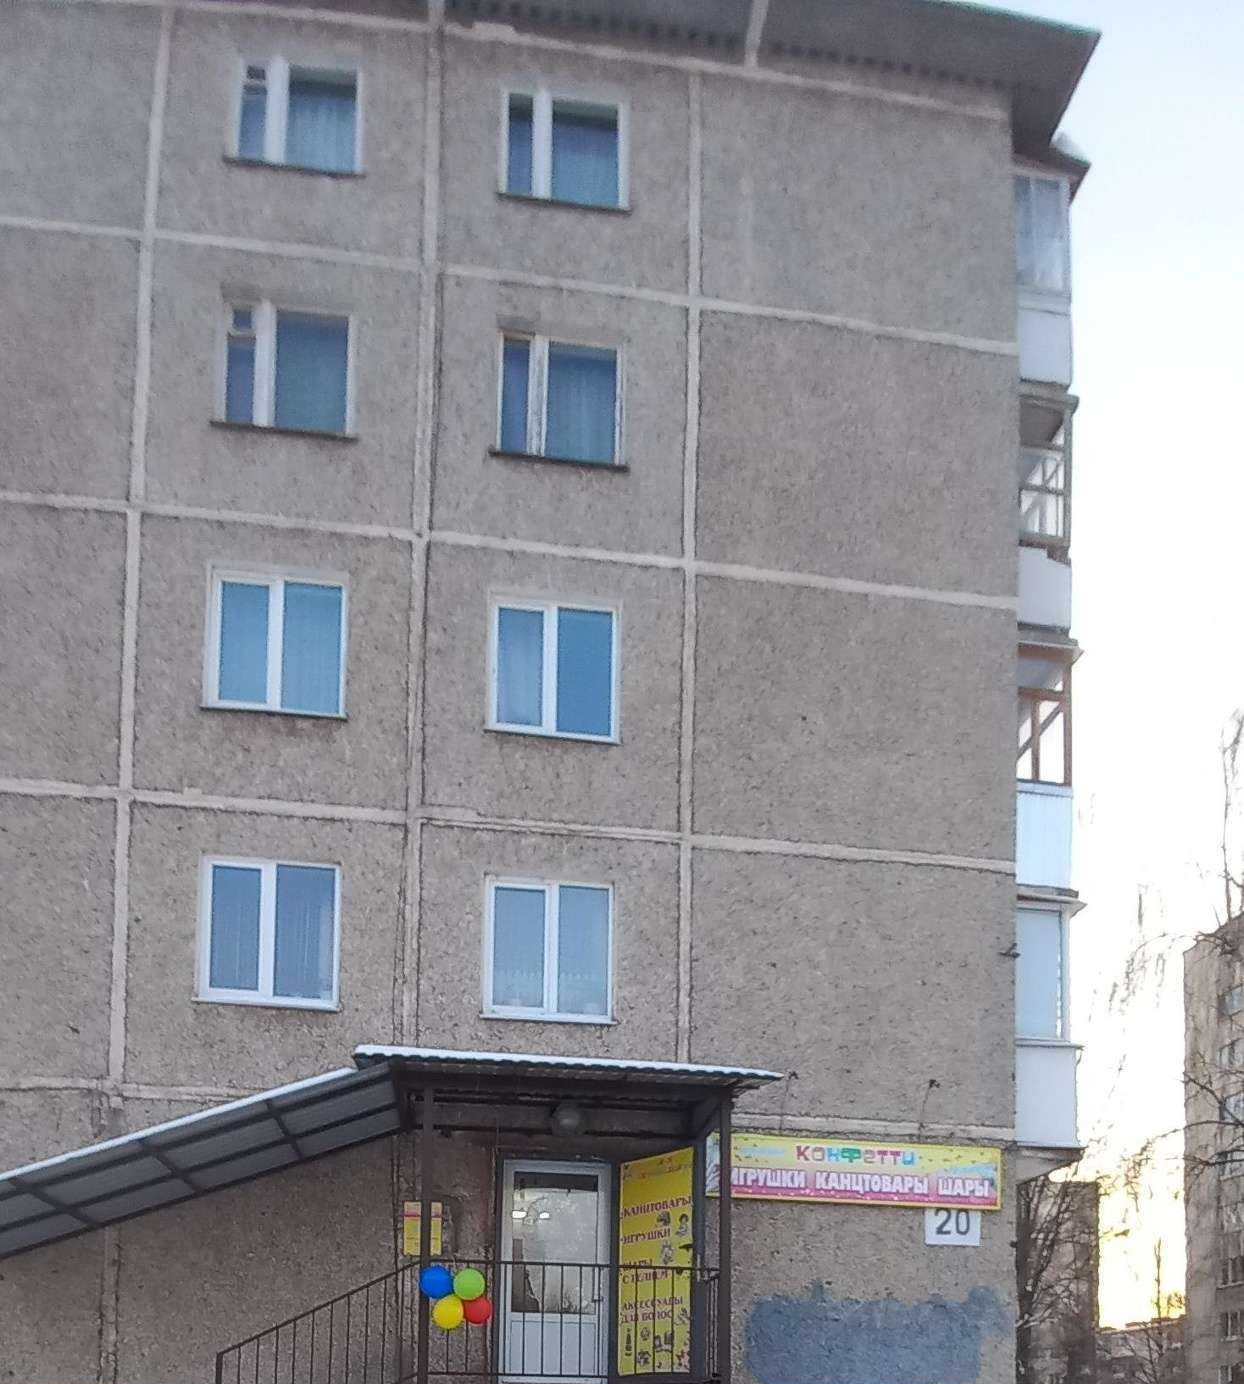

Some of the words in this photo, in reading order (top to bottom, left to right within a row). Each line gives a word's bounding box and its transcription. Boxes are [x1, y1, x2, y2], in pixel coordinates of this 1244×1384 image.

[815, 1171, 928, 1194] КАНЦТОВАРЫ
[937, 1176, 990, 1198] ШАРЫ
[622, 1227, 671, 1245] ИГРУШКИ
[934, 1209, 971, 1236] 20
